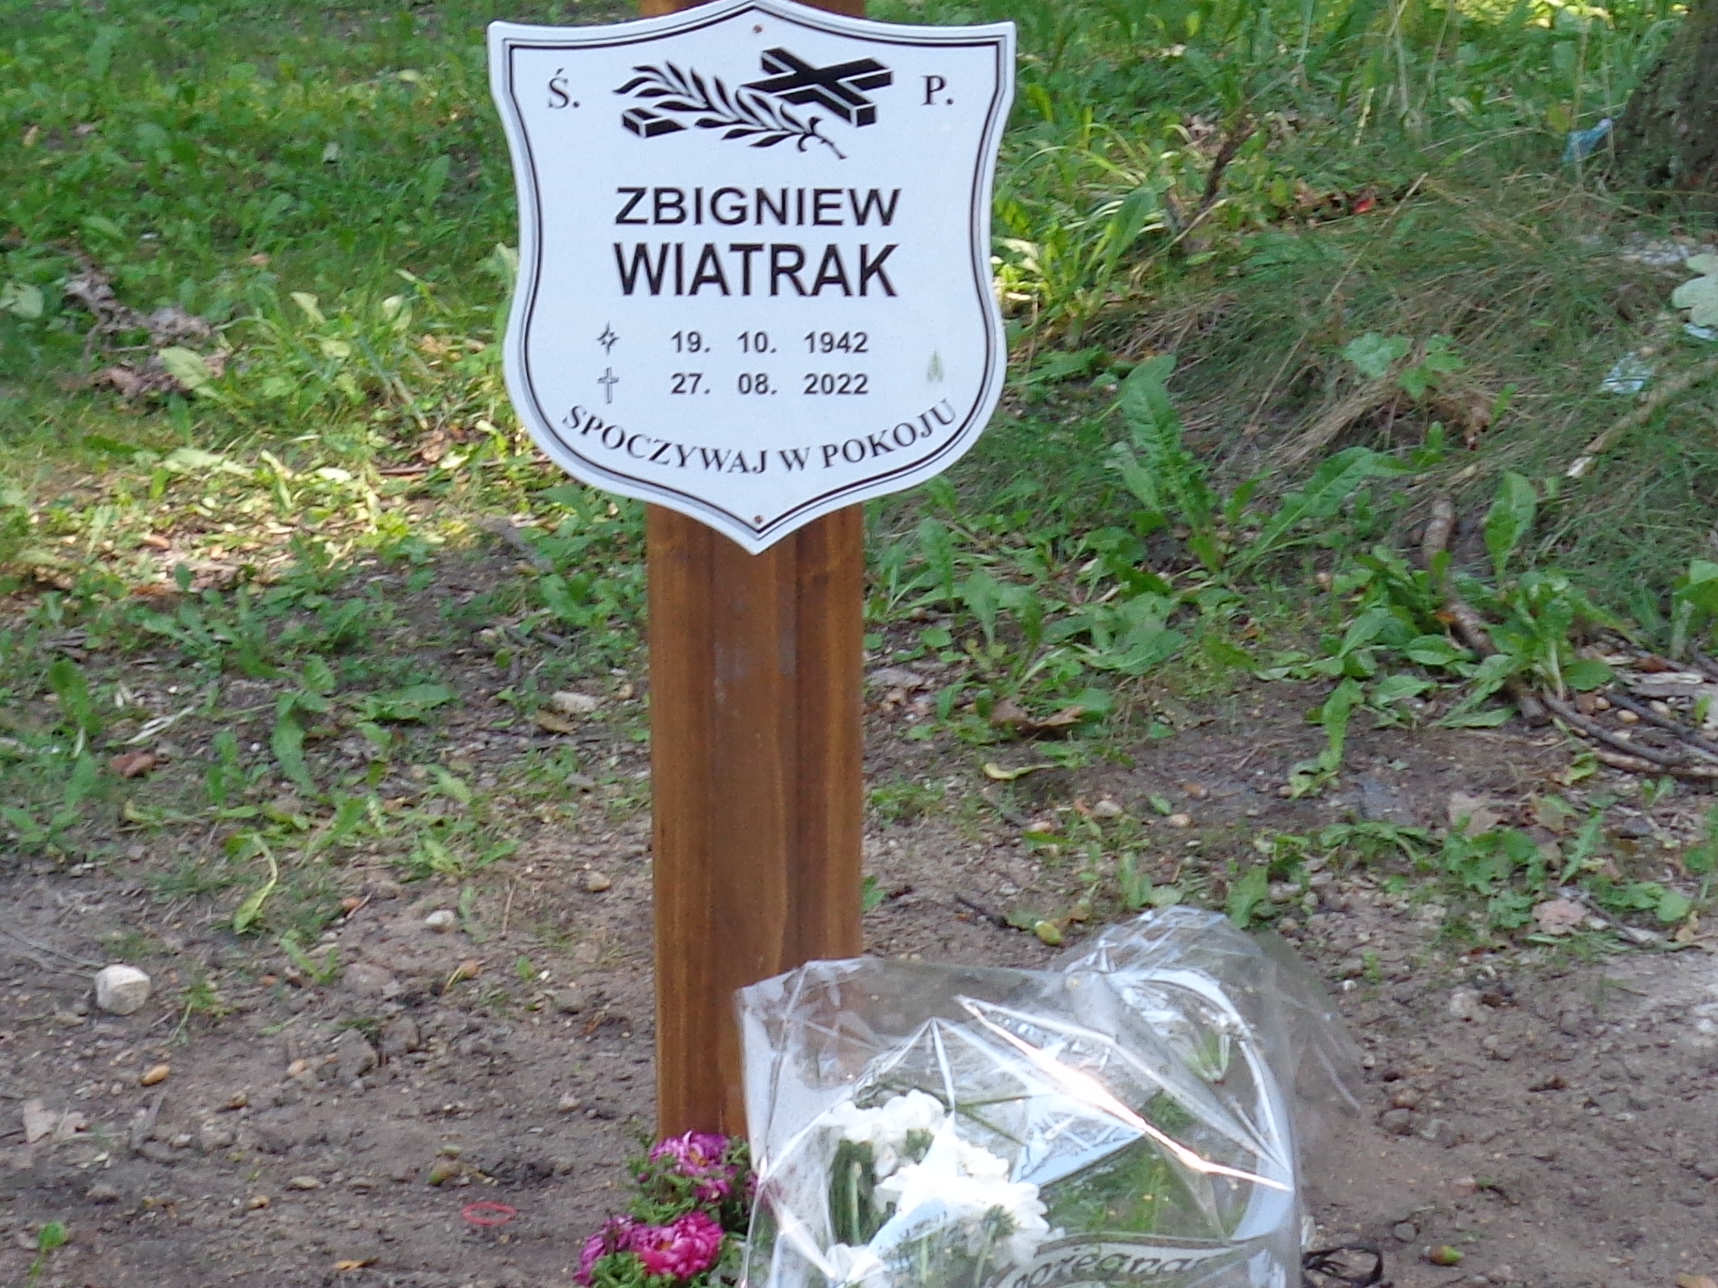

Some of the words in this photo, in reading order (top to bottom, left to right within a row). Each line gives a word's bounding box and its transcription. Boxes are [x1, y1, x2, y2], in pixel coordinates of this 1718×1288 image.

[547, 68, 581, 109] Ś.
[921, 75, 954, 107] P.
[615, 187, 902, 227] ZBIGNIEW
[613, 243, 900, 297] WIATRAK
[671, 331, 711, 354] 19.
[737, 331, 777, 354] 10.
[804, 331, 869, 354] 1942
[670, 373, 711, 396] 27.
[737, 373, 777, 396] 08.
[803, 373, 869, 396] 2022
[561, 404, 768, 475] SPOCZYWAJ
[782, 447, 811, 474] W
[821, 398, 959, 469] POKOJU
